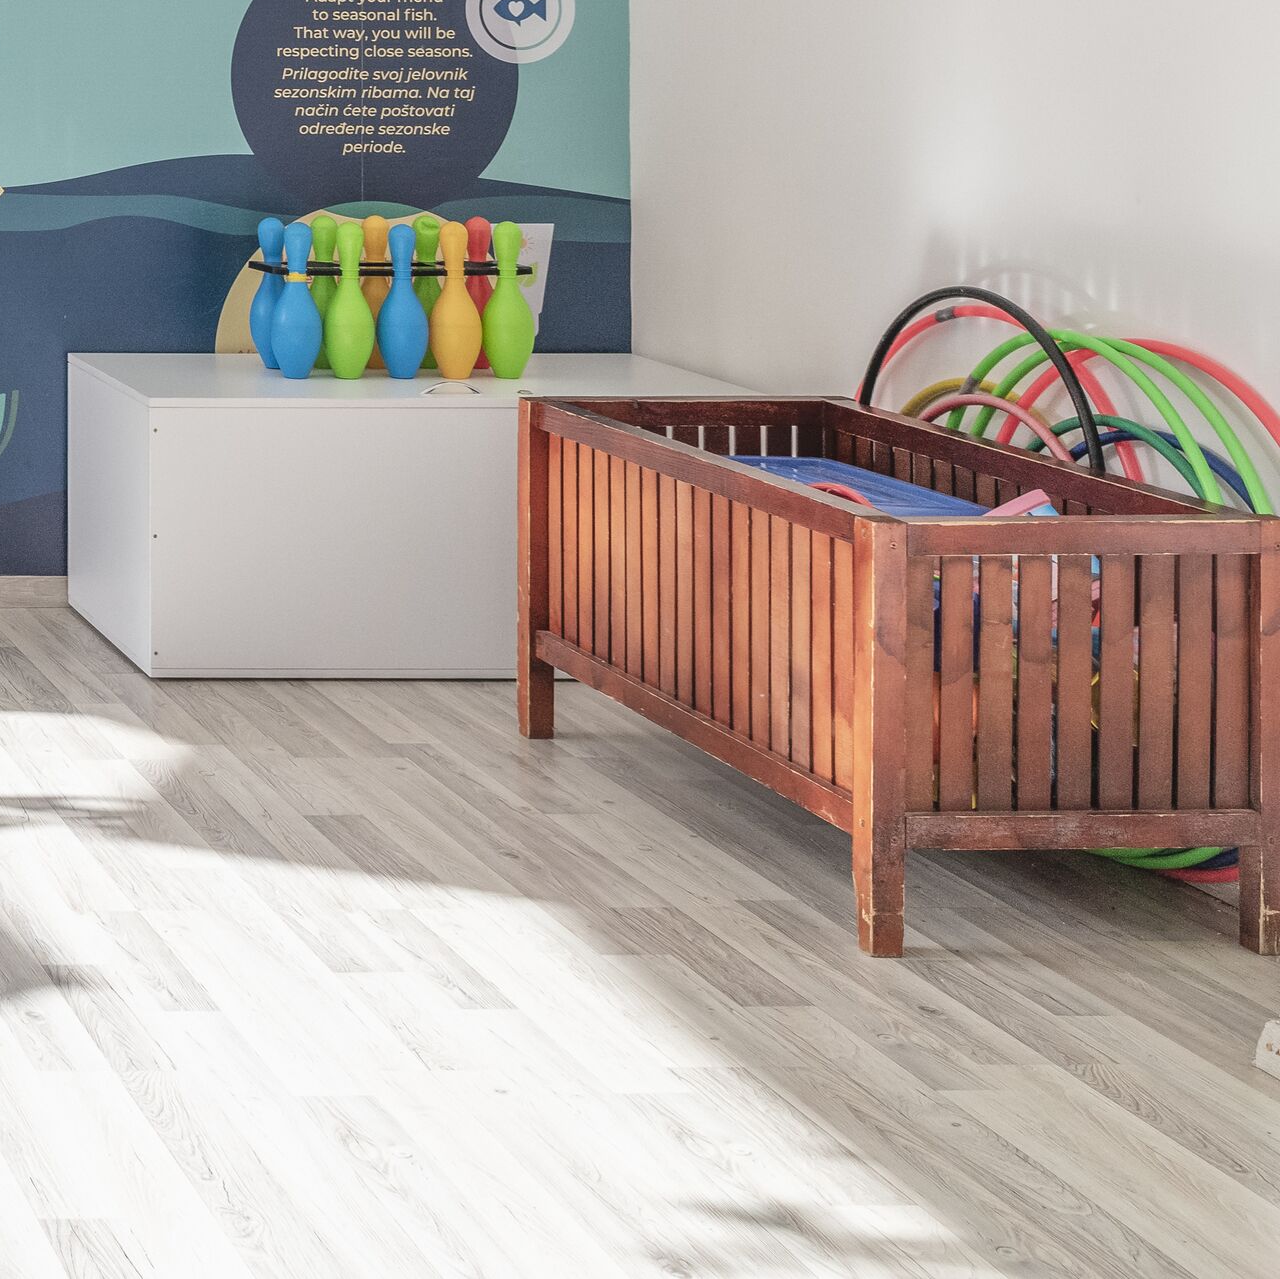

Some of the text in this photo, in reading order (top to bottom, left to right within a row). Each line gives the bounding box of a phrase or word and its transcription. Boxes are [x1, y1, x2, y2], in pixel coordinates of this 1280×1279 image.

[311, 7, 438, 22] to seasonal fish.
[281, 66, 470, 84] Prilagodite svoj jelovnik
[341, 139, 407, 157] periode.
